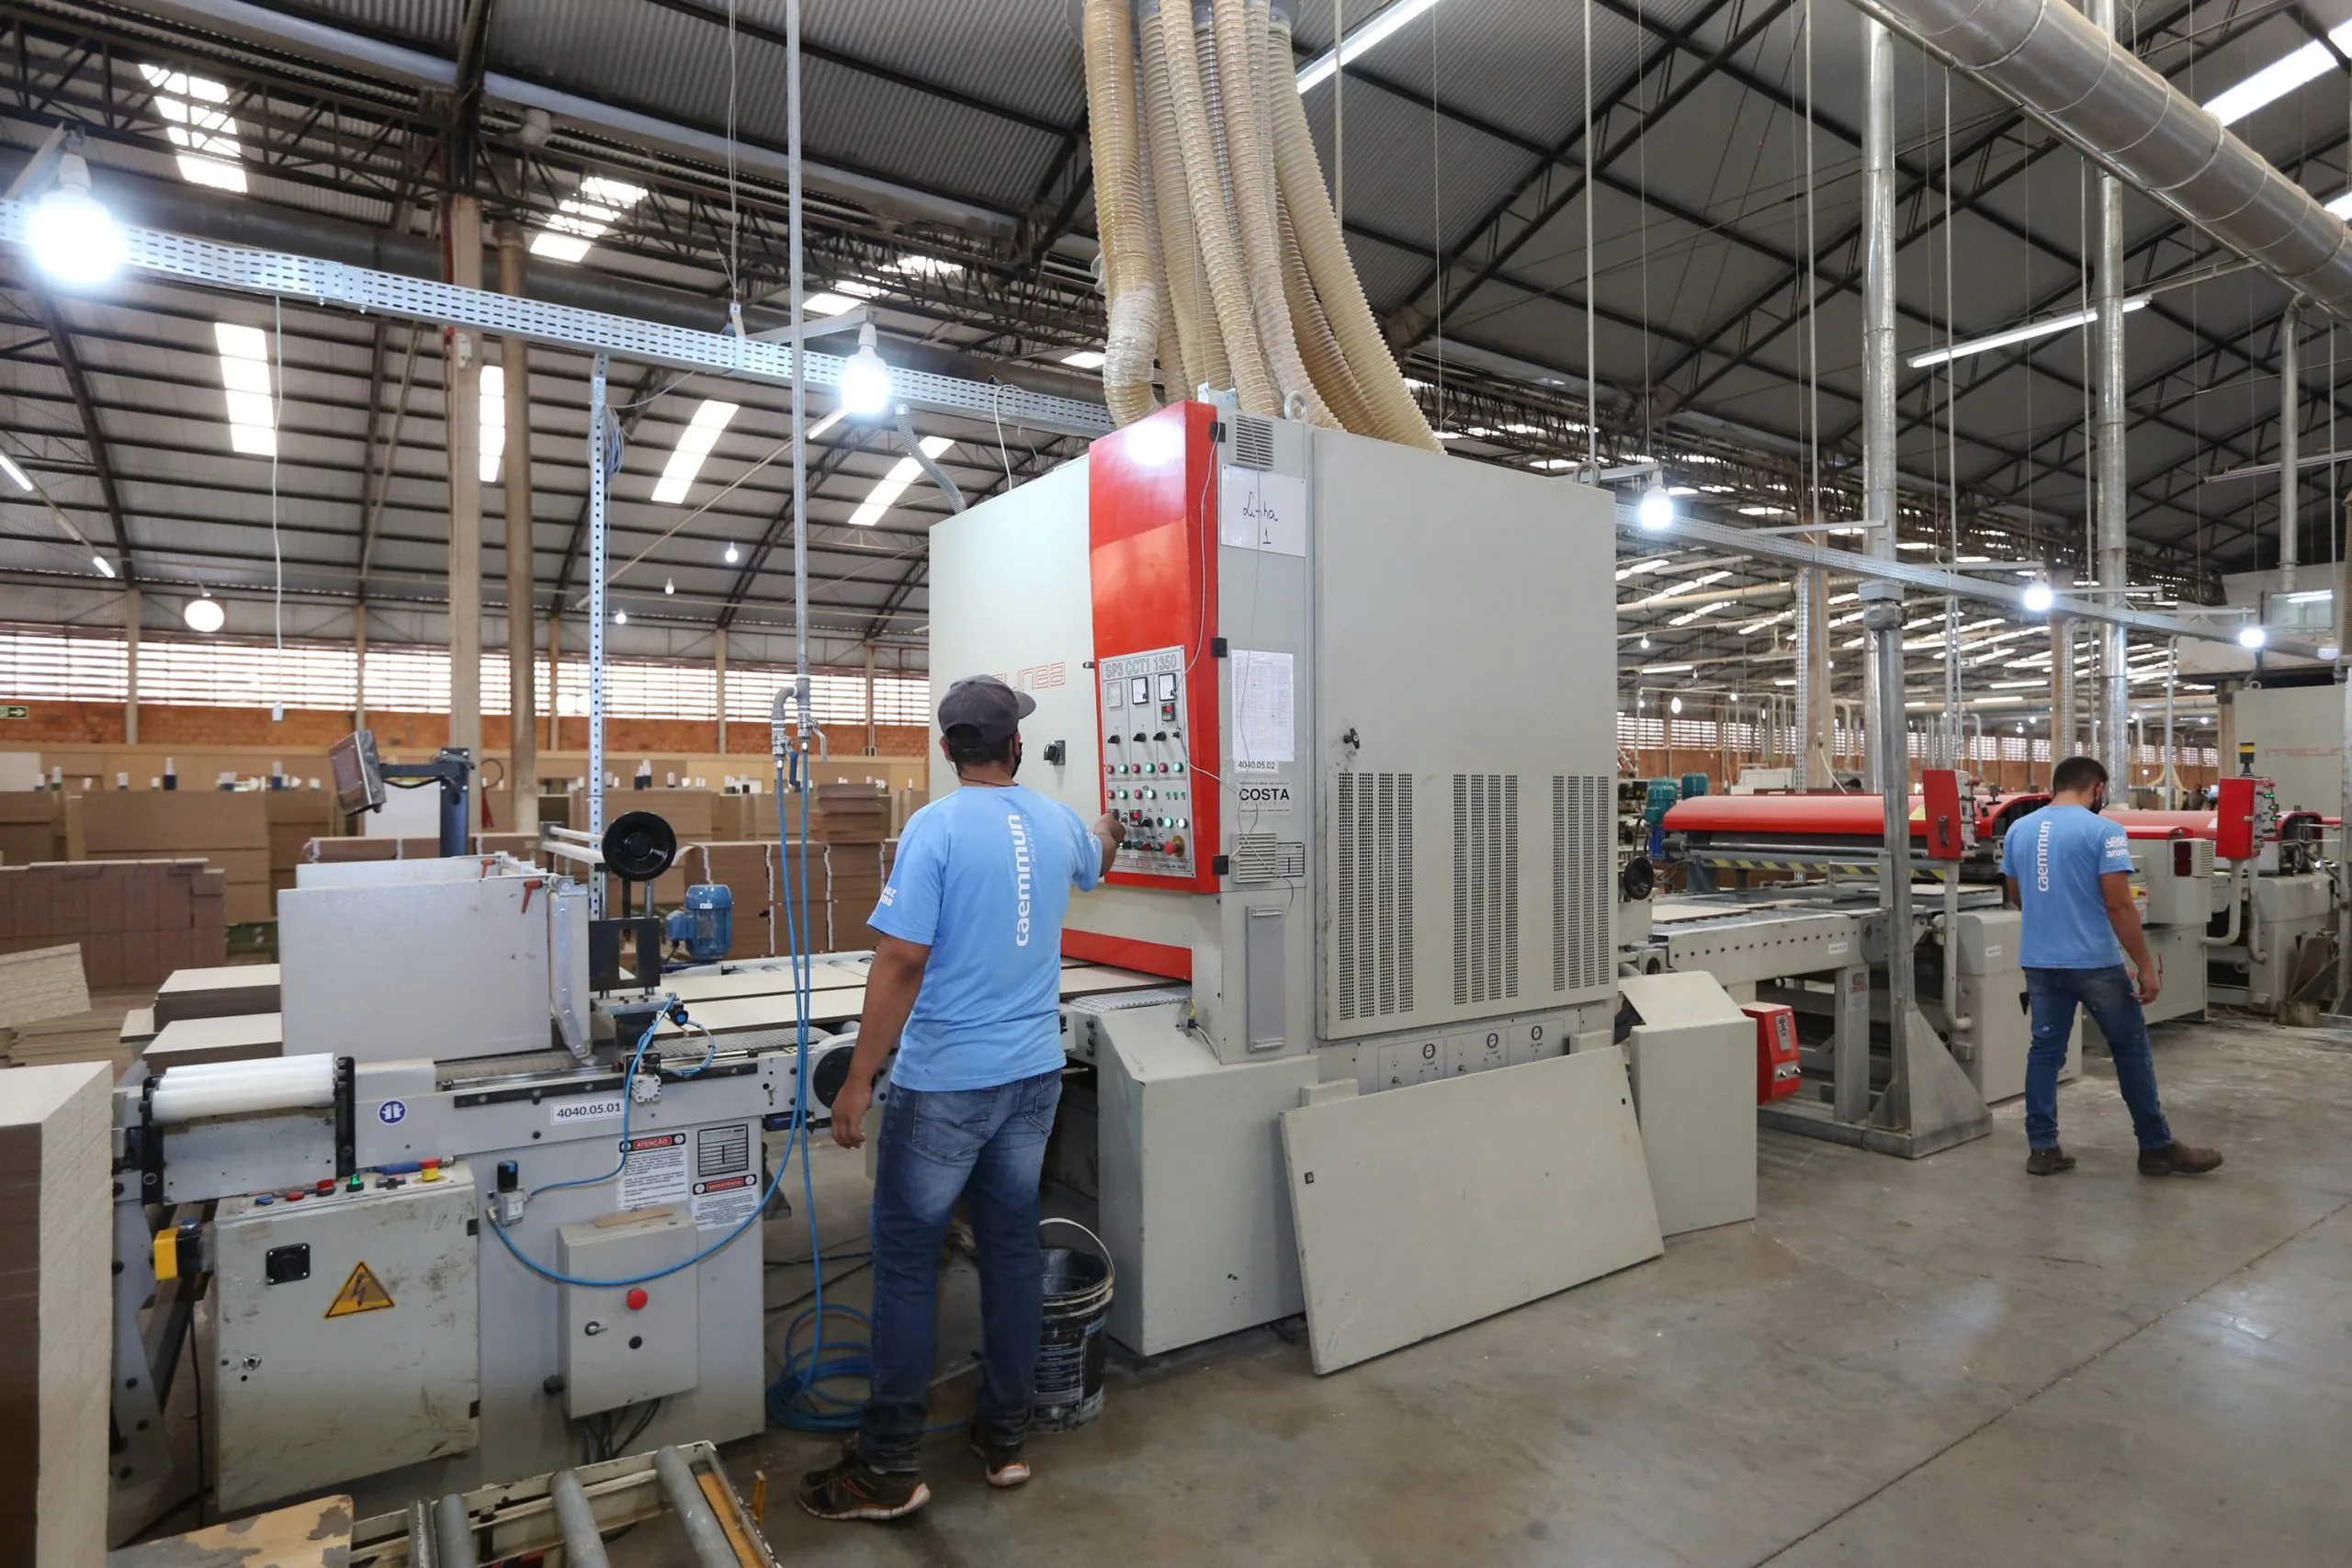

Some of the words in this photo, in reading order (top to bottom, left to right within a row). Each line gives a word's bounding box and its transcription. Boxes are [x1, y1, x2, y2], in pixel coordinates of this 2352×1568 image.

[1243, 491, 1278, 522] Linha
[1262, 527, 1272, 544] 1
[1105, 662, 1124, 678] SP3
[1125, 657, 1150, 675] CCT1
[1154, 653, 1177, 671] 1350
[1238, 761, 1276, 770] 4040.05.02
[1238, 788, 1290, 801] COSTA
[2036, 820, 2052, 892] caemmun
[1007, 814, 1031, 946] caemmun
[557, 1102, 621, 1118] 4040.05.01
[636, 1137, 669, 1148] ATENÇÃO
